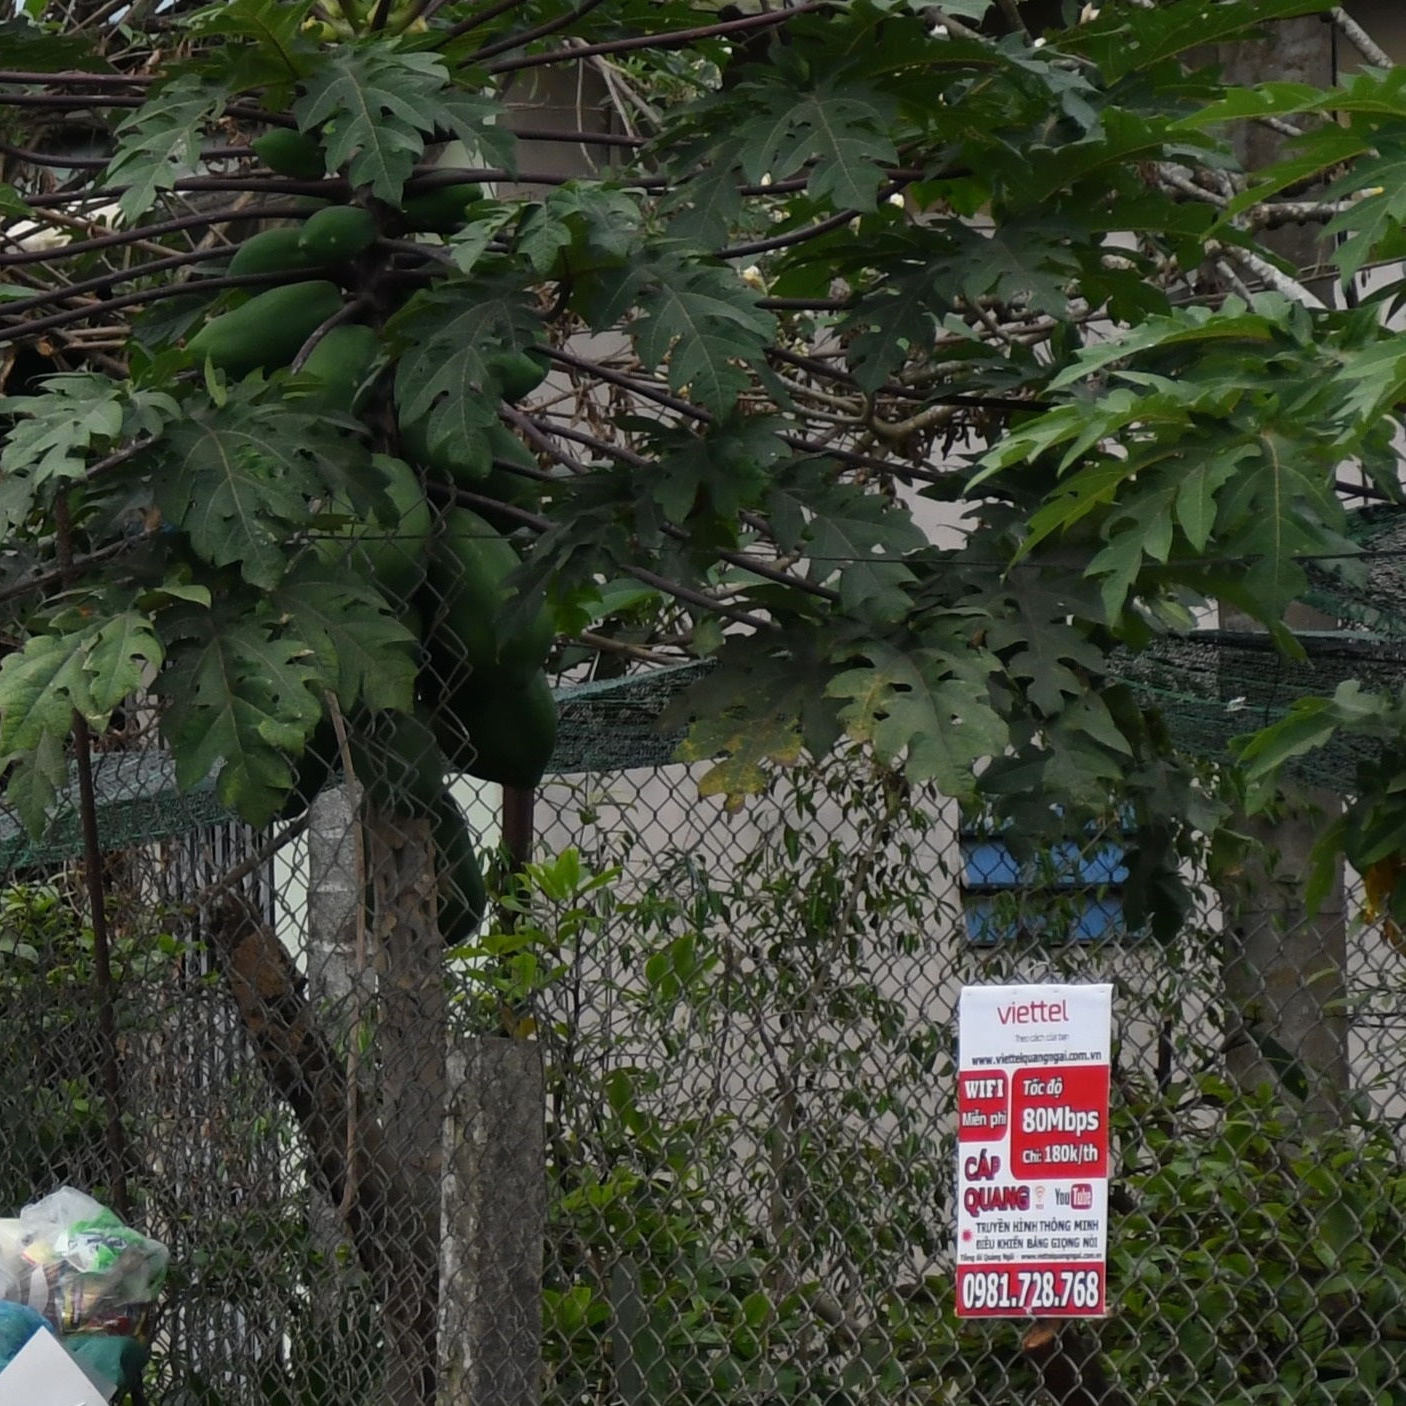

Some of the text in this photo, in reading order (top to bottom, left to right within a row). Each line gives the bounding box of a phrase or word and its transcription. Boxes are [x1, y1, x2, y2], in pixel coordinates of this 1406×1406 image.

[997, 998, 1070, 1025] viettel
[964, 1078, 1005, 1099] WIFI
[1022, 1075, 1064, 1098] Tốc độ
[1022, 1106, 1100, 1137] 80Mbps
[964, 1148, 1002, 1182] CÁP
[1044, 1143, 1099, 1165] 180k/th
[963, 1185, 1031, 1218] QUANG
[1039, 1216, 1072, 1233] THÔNG
[1073, 1219, 1099, 1231] MINH
[962, 1270, 1101, 1309] 0981.728.768
